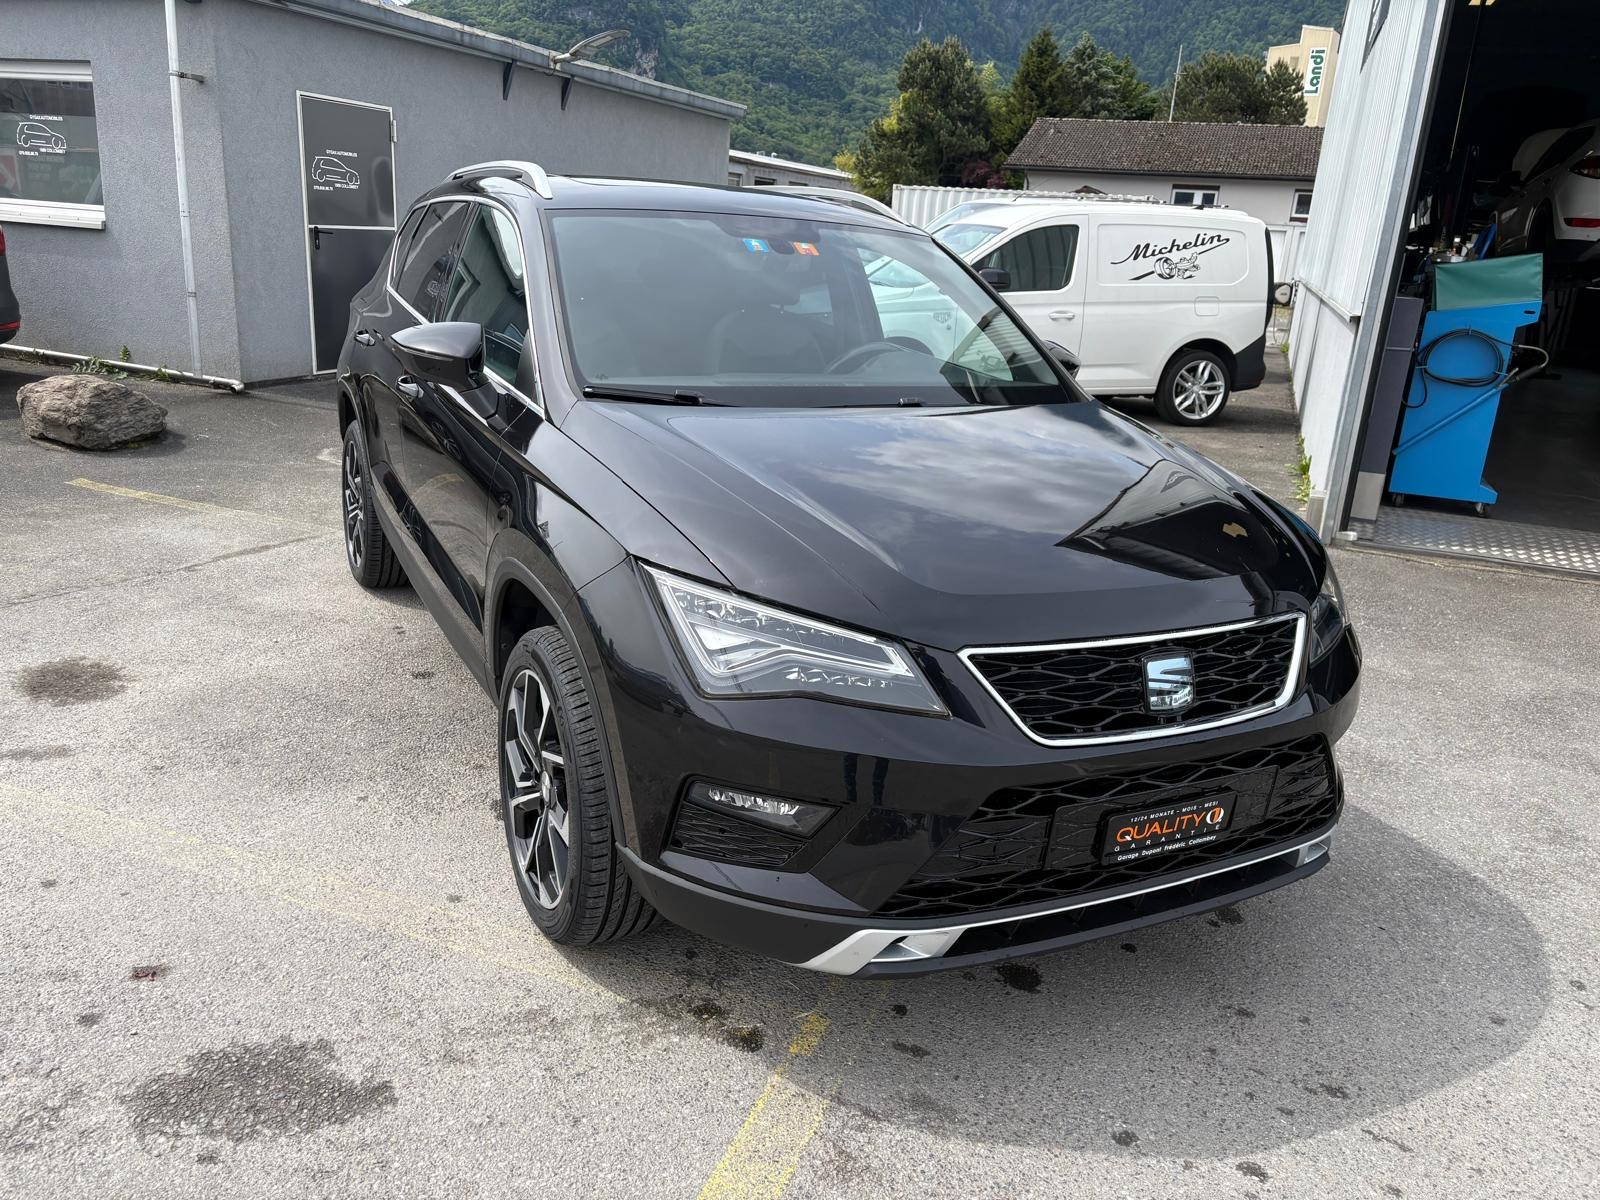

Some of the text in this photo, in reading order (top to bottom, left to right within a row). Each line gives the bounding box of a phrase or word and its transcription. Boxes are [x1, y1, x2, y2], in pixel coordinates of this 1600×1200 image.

[1304, 49, 1326, 94] Landi
[1110, 233, 1230, 265] Michelin
[1116, 811, 1206, 843] QUALITY
[1150, 810, 1175, 819] MONATE
[1114, 824, 1221, 852] GARANTIE
[1142, 848, 1162, 856] Dupont
